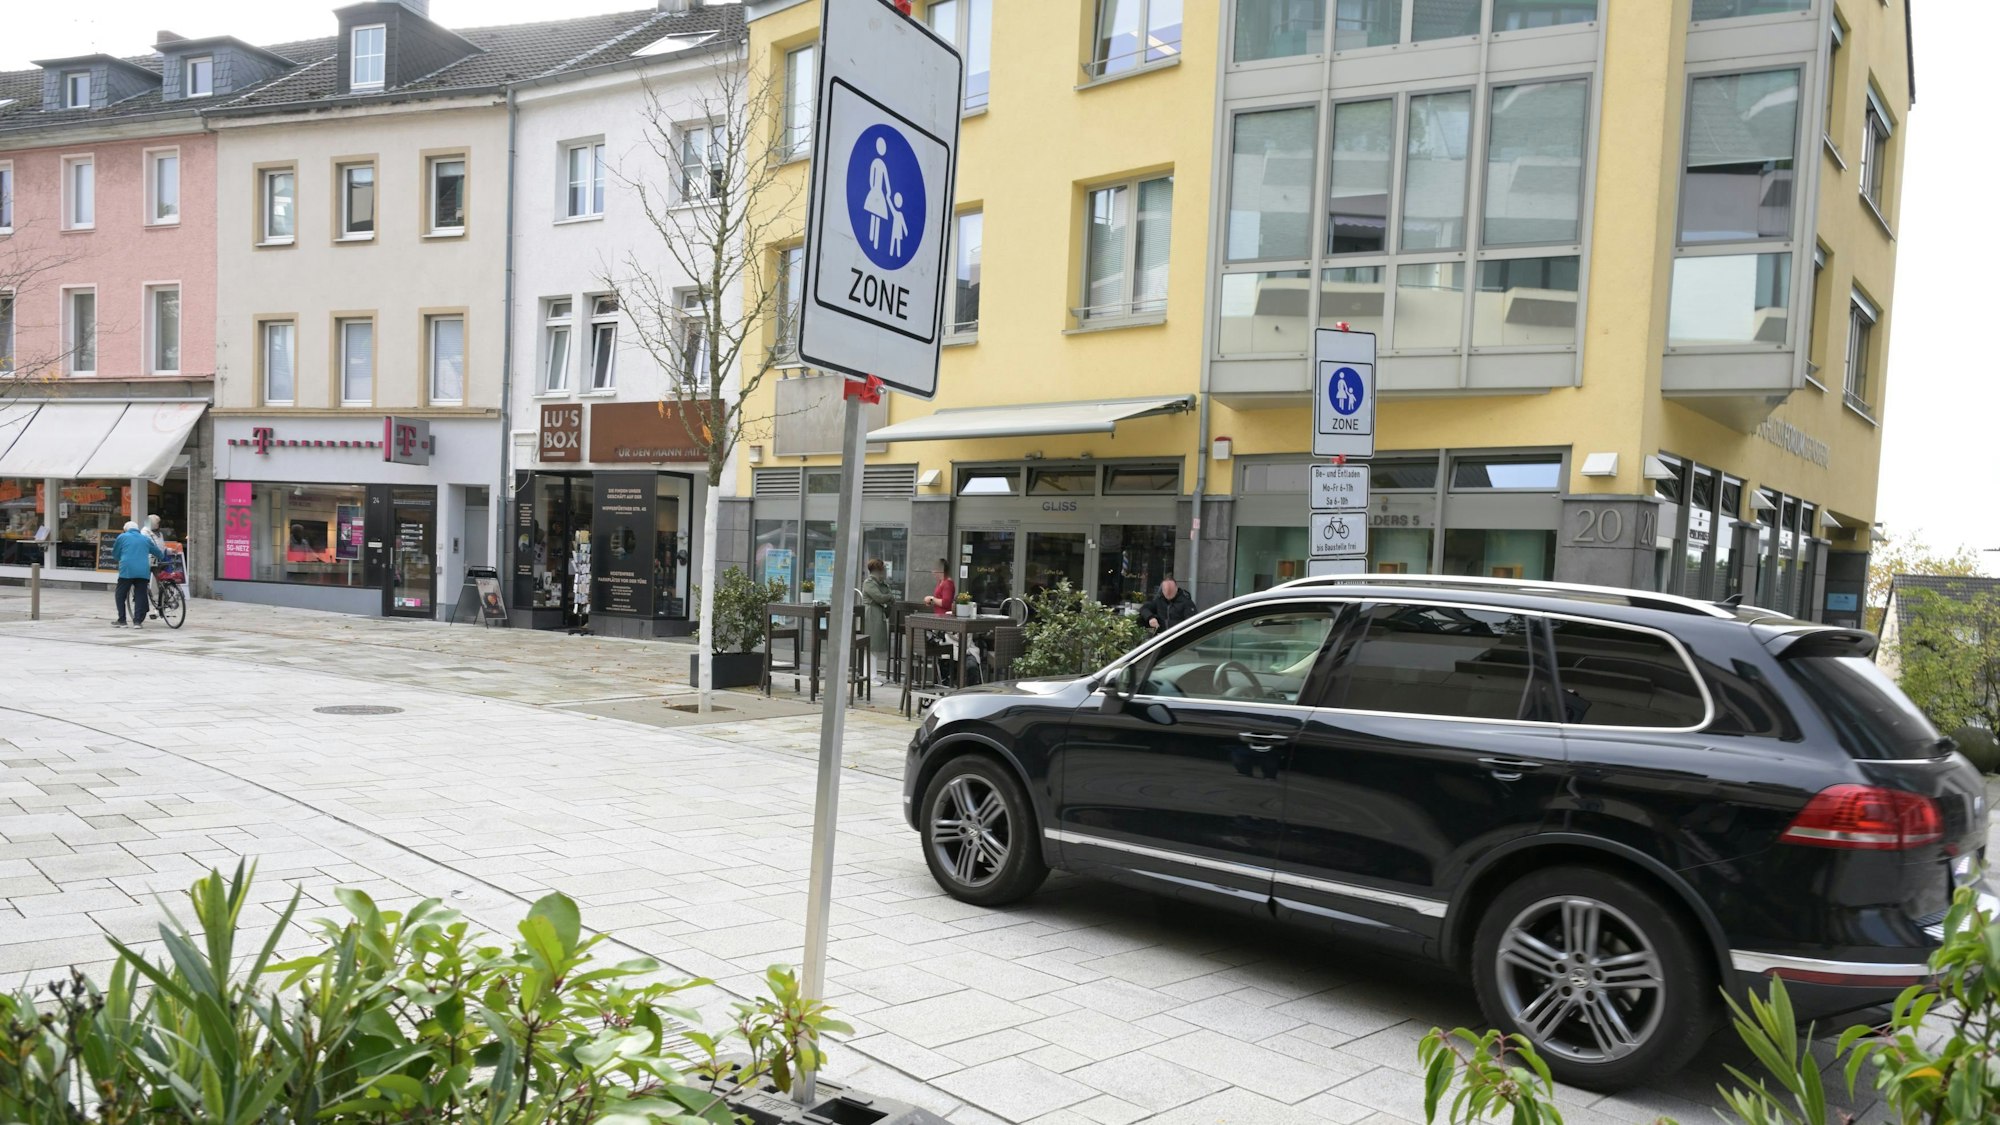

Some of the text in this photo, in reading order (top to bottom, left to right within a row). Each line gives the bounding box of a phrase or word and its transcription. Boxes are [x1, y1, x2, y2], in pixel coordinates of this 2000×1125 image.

[848, 266, 910, 321] ZONE
[544, 409, 579, 428] LU'S
[1332, 417, 1359, 431] ZONE
[543, 431, 579, 449] BOX
[632, 447, 650, 457] DEN
[652, 447, 682, 457] MANN
[684, 447, 700, 457] MIT
[1326, 470, 1337, 478] und
[1338, 469, 1361, 478] Entladen
[1322, 483, 1339, 492] Mo-Fr
[1042, 501, 1078, 512] GLISS
[1326, 496, 1333, 506] Sa
[226, 508, 251, 528] 5G
[1412, 514, 1420, 526] 5
[1573, 508, 1622, 543] 20
[1641, 510, 1656, 546] 20
